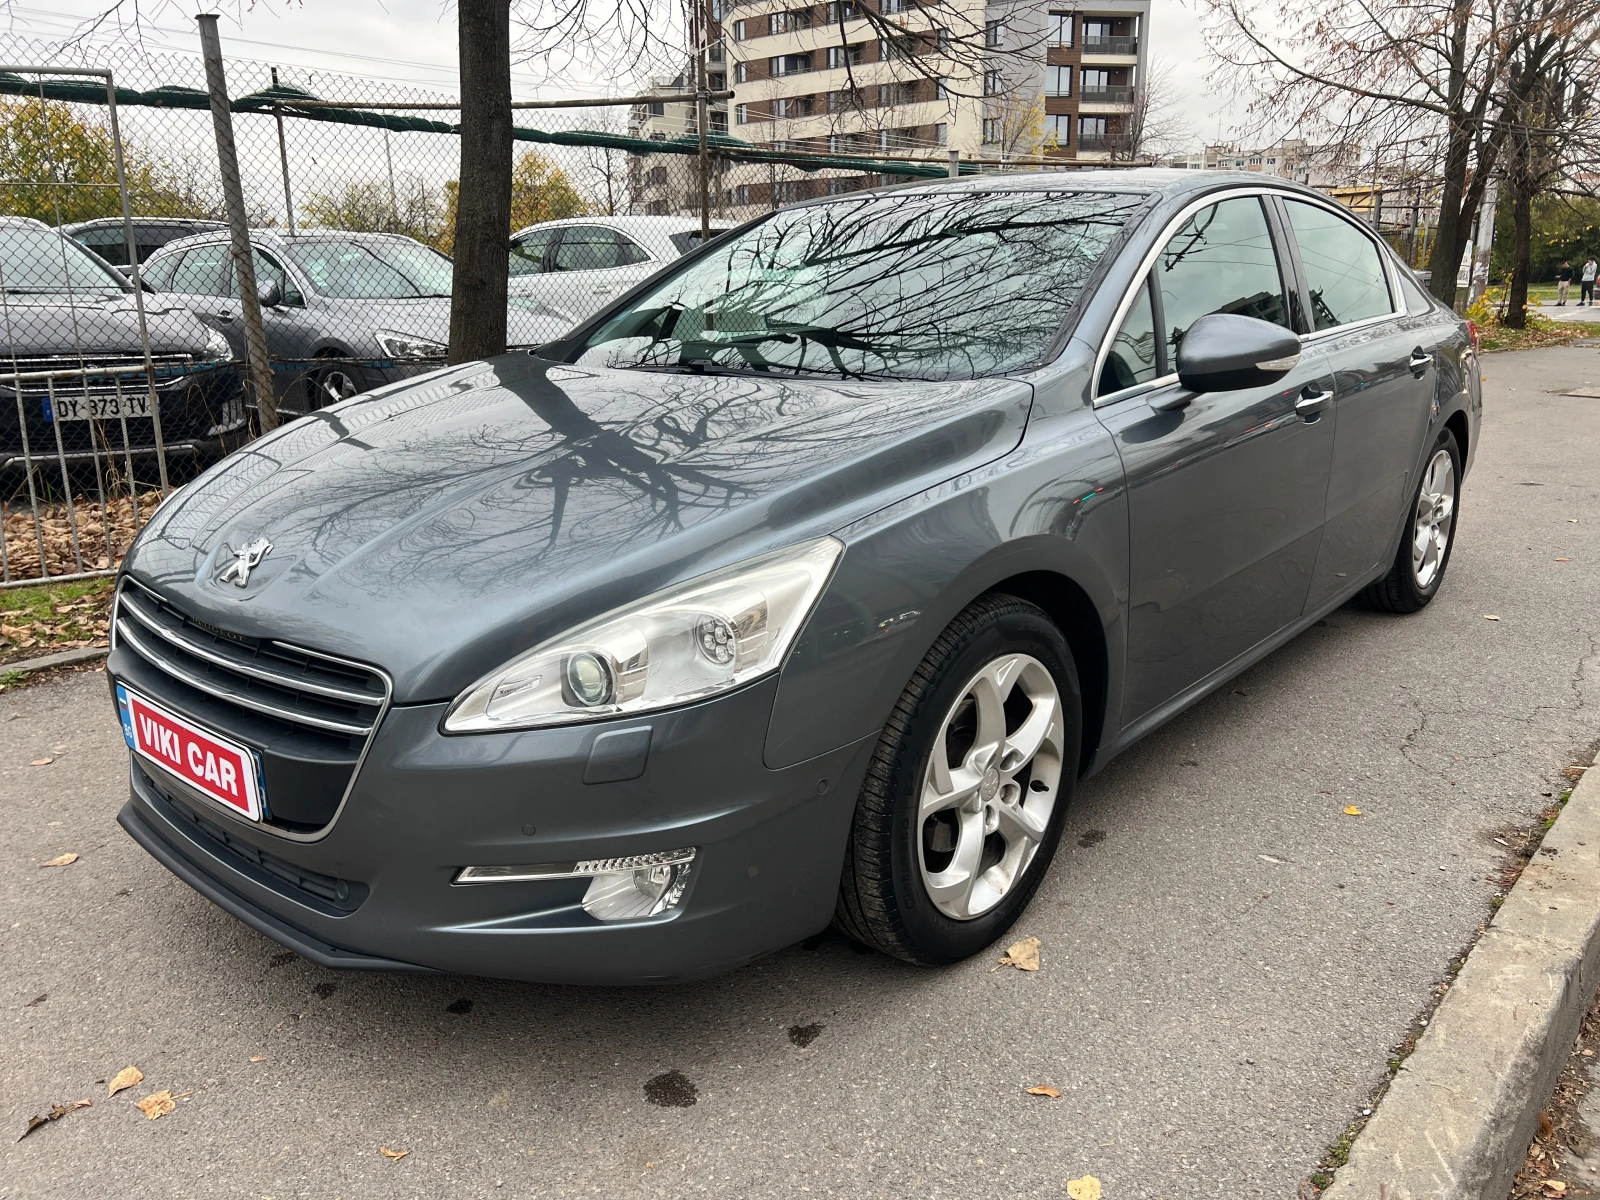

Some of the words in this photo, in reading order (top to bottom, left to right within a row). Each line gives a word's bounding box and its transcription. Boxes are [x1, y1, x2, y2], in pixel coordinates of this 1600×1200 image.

[192, 617, 244, 641] PEUGEOT
[139, 712, 182, 765] VIKI
[187, 741, 239, 797] CAR
